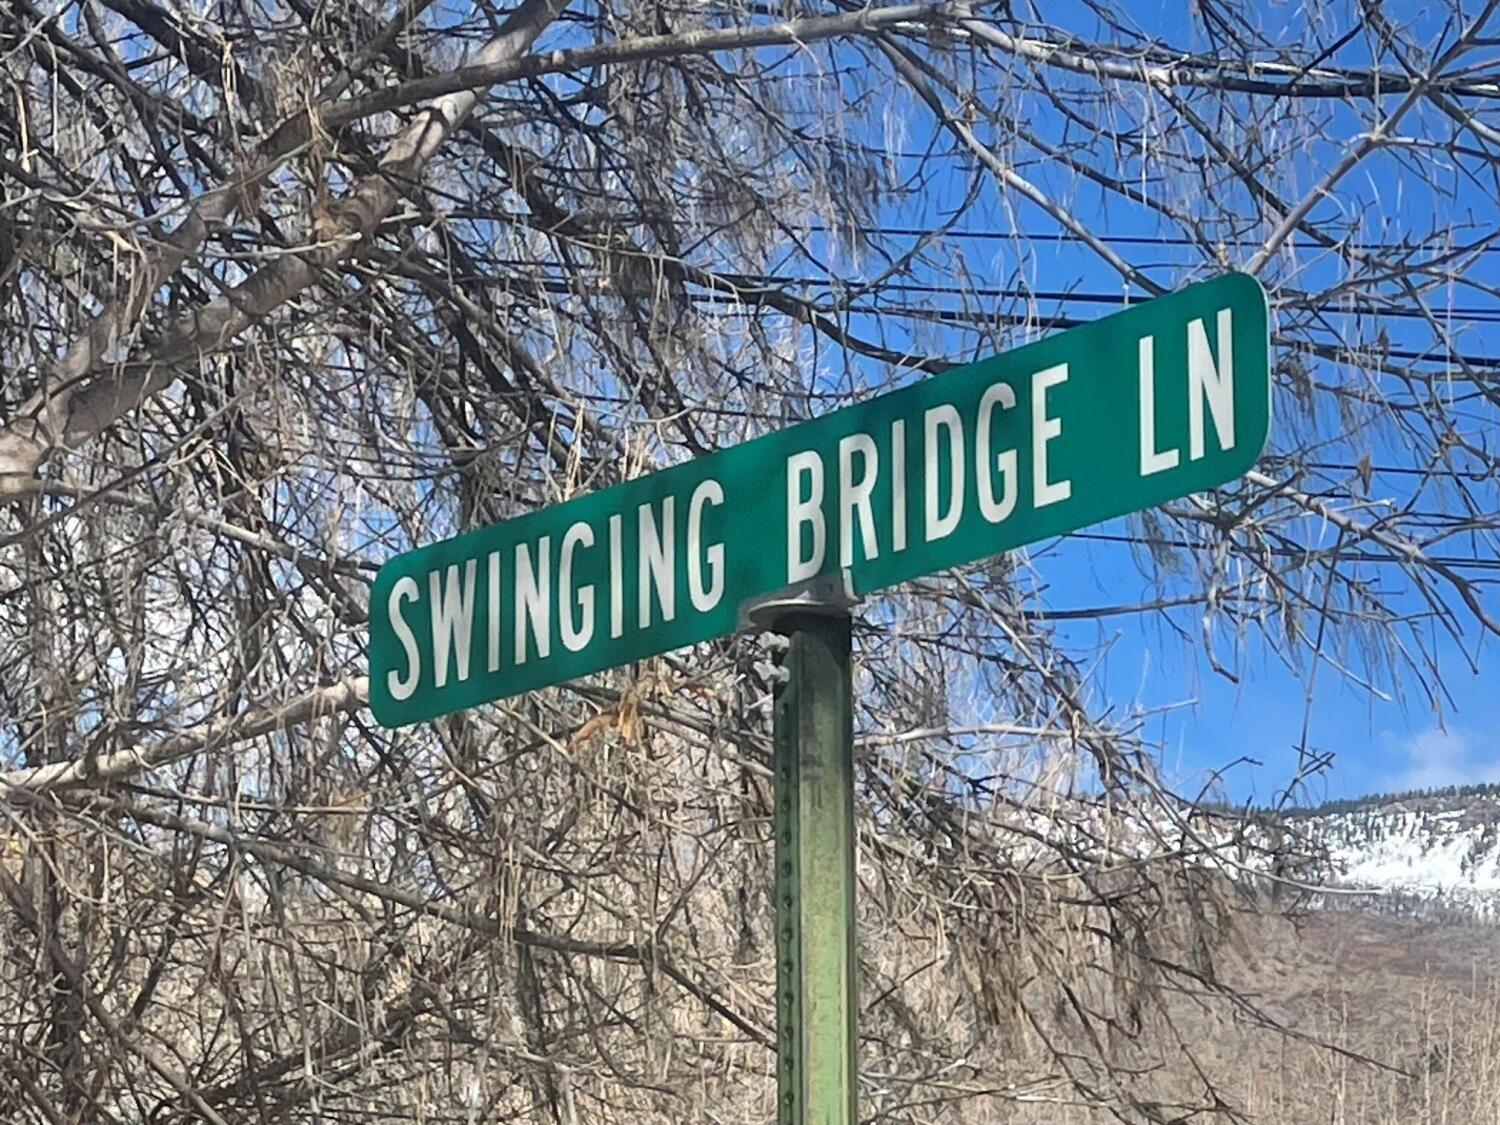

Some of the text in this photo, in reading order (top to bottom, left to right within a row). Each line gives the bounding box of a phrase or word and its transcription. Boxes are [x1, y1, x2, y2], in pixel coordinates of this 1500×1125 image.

[387, 308, 1235, 702] SWINGING BRIDGE LN
